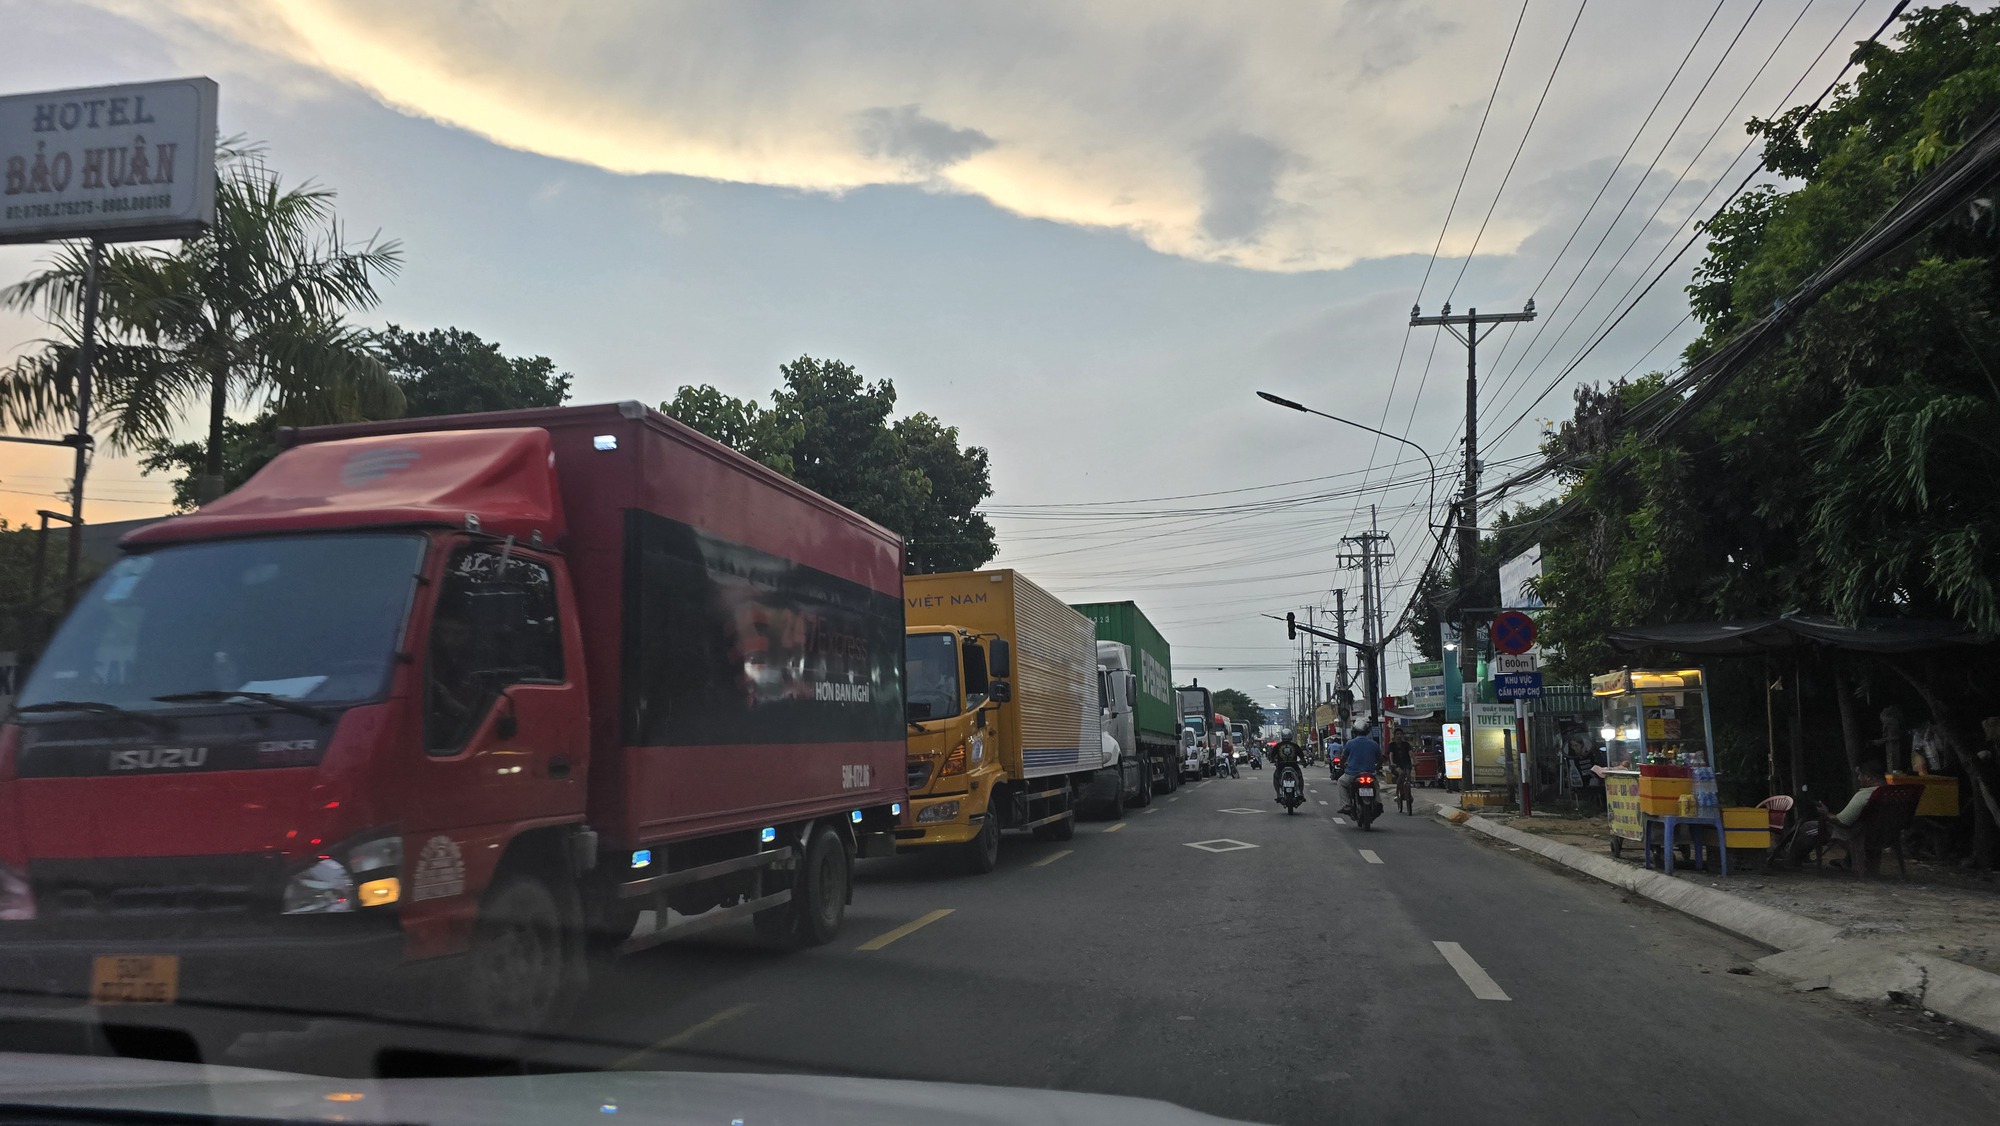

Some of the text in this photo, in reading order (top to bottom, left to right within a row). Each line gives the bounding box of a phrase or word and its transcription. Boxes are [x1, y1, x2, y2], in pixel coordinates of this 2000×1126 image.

[33, 95, 155, 132] HOTEL
[5, 134, 177, 195] BẢO HUÂN
[908, 592, 987, 609] VIỆT NAM
[1505, 659, 1529, 668] 600m
[1505, 674, 1532, 686] KHU VỰC
[815, 680, 834, 701] HƠN
[835, 682, 850, 707] BẠN
[1513, 688, 1526, 698] HỌP
[1527, 687, 1541, 698] CHỢ
[1477, 712, 1501, 725] TUYẾT
[108, 748, 208, 770] ISUZU
